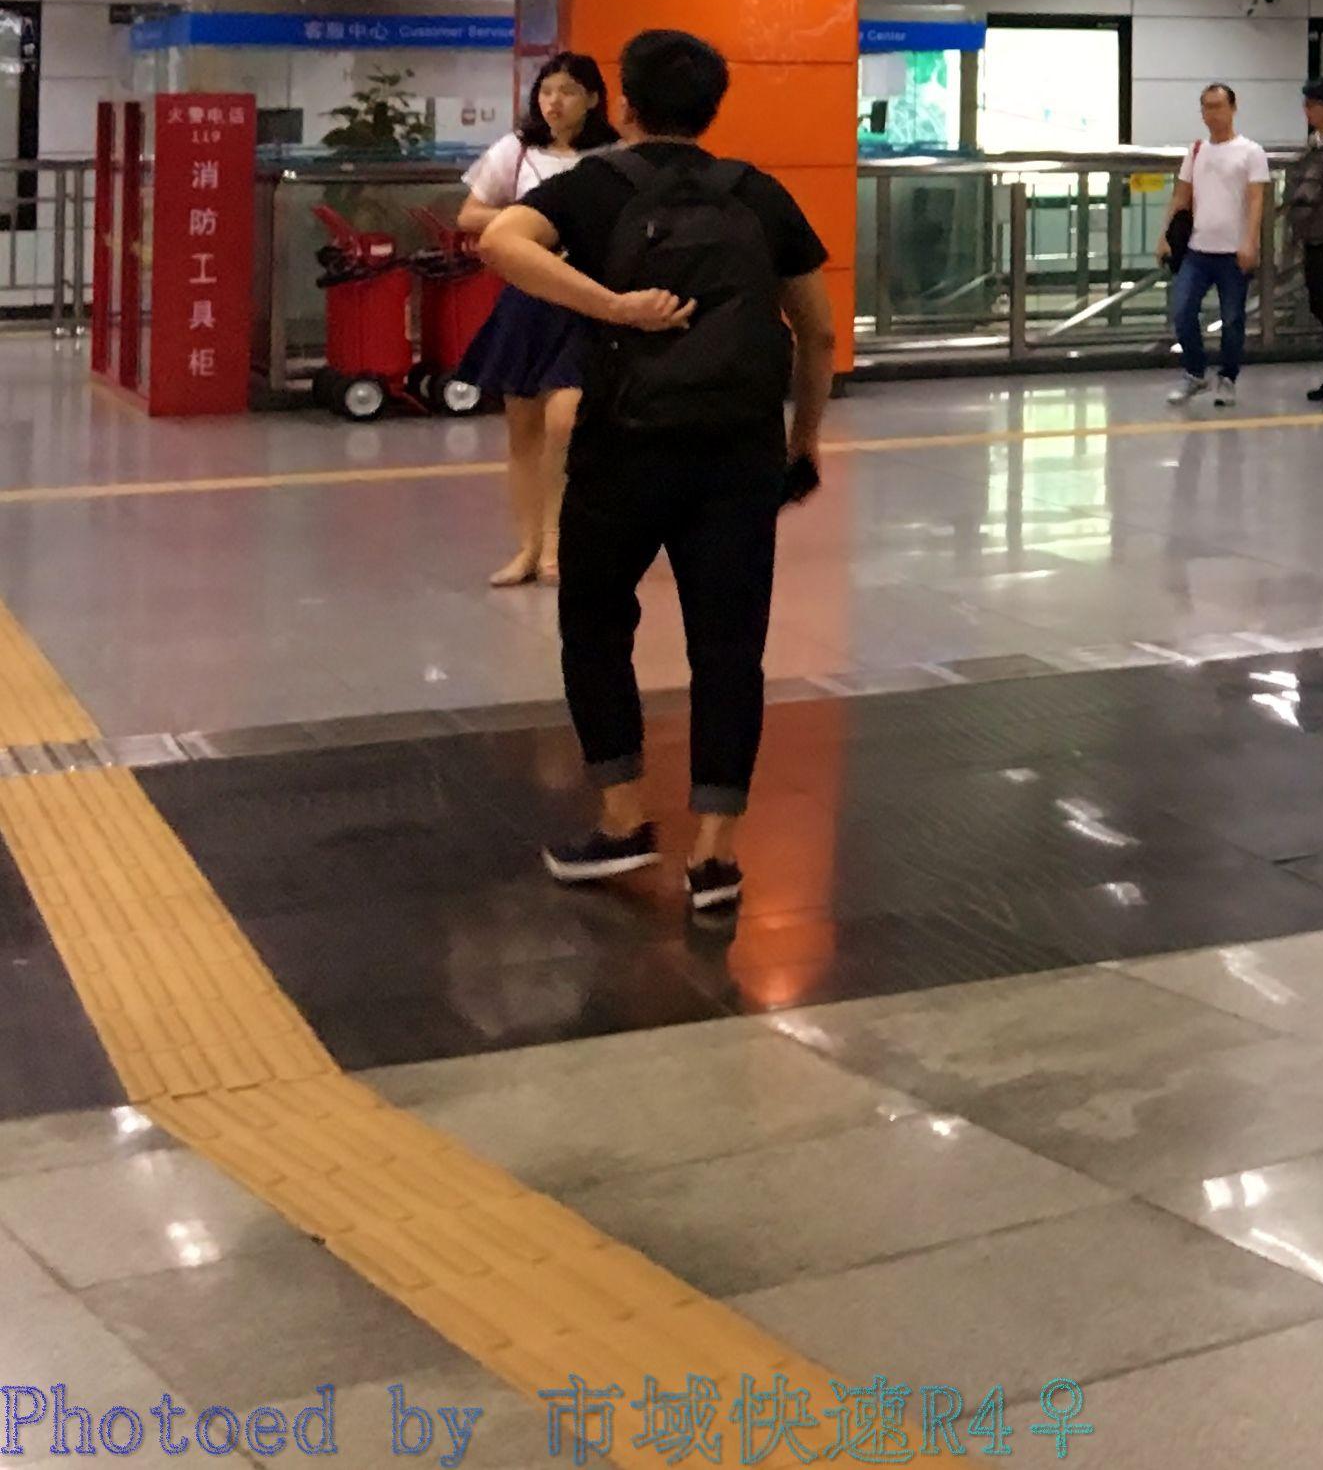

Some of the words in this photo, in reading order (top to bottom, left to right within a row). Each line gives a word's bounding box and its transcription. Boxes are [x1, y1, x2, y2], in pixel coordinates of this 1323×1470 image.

[192, 130, 221, 143] 119
[189, 160, 219, 376] 消防工具柜
